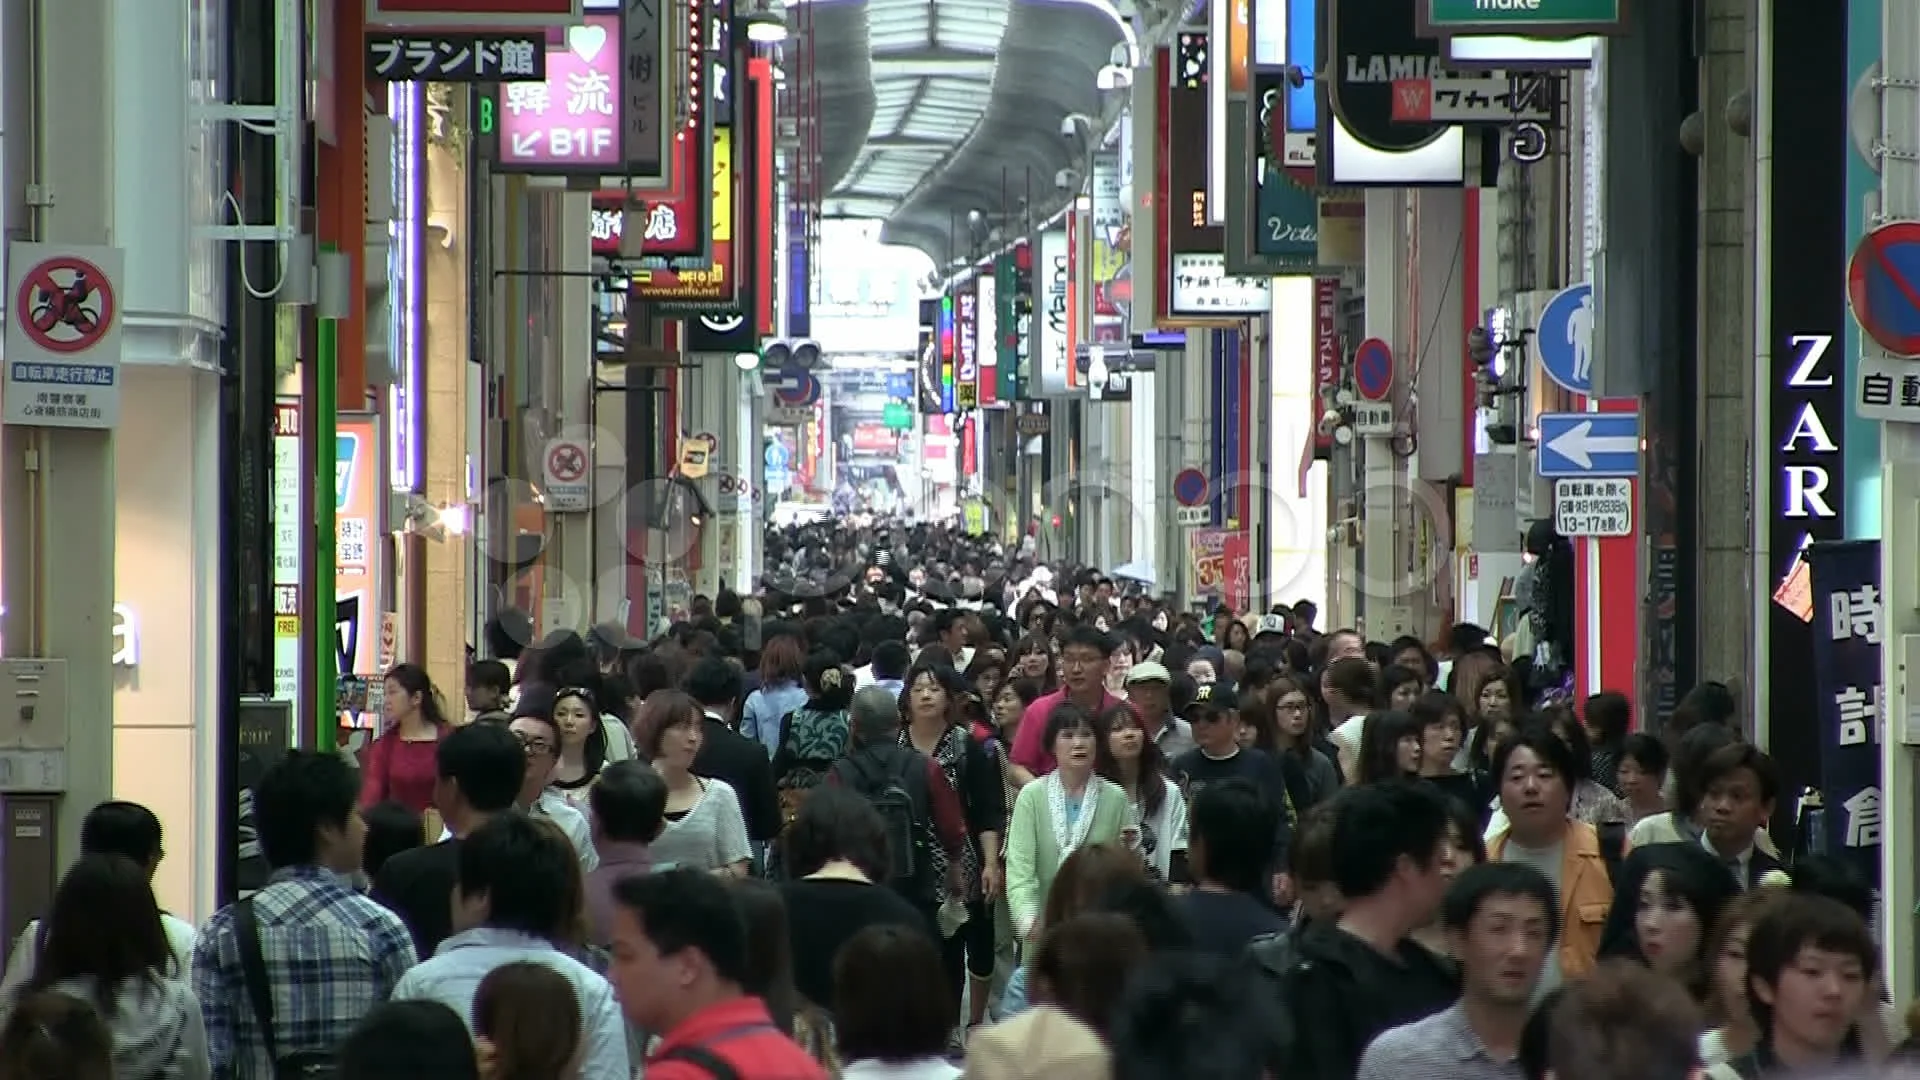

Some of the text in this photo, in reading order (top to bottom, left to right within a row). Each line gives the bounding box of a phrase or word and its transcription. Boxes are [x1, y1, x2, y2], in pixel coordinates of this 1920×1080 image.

[371, 39, 534, 75] ブランド館
[549, 127, 611, 156] B1F
[15, 365, 111, 384] 自転車走行禁止
[278, 620, 295, 632] FREE
